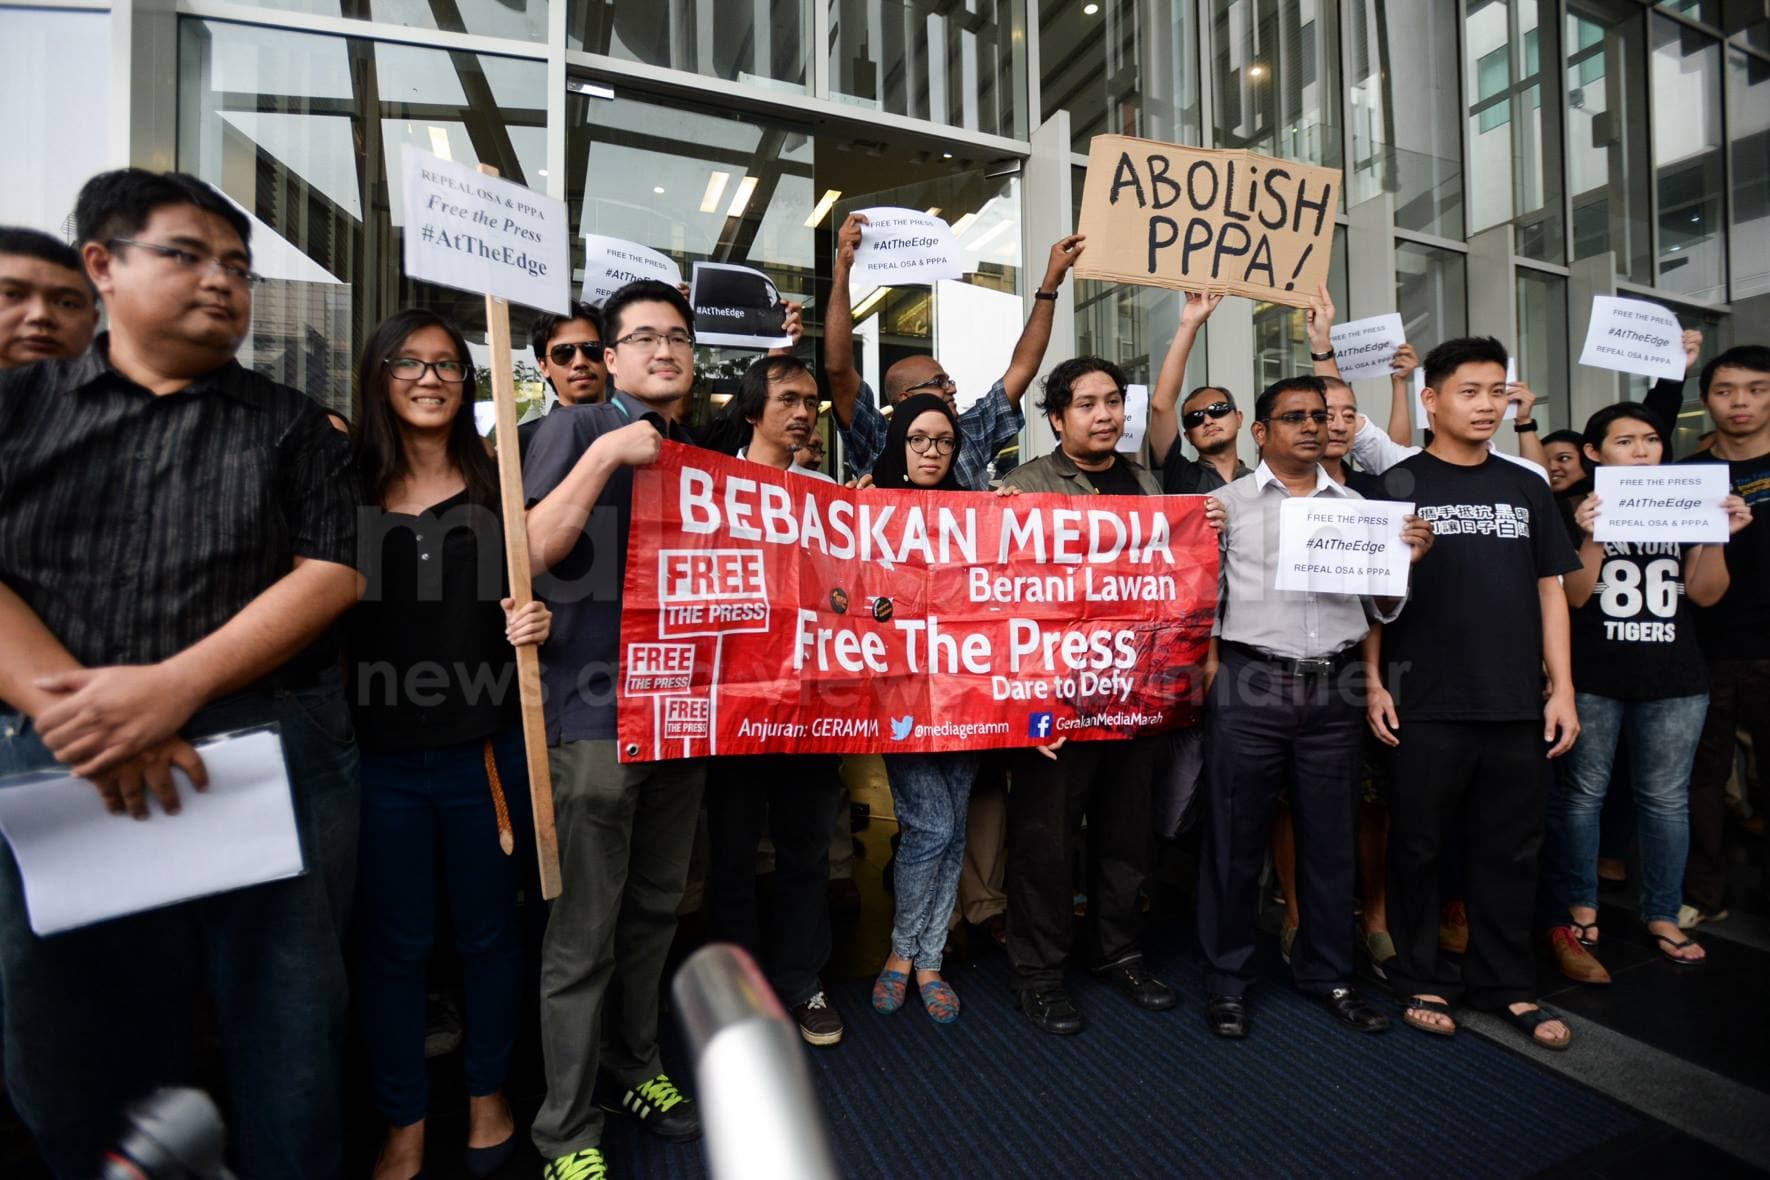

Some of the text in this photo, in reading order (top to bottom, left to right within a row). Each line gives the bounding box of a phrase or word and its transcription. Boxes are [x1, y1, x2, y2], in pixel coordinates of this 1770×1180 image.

[421, 168, 546, 221] REPEAL OSA & PPPA
[426, 193, 542, 244] Free the Press
[870, 218, 935, 228] FREE THE PRESS
[421, 223, 548, 278] #AtTheEdge
[872, 236, 940, 251] #AtTheEdge
[606, 248, 668, 271] FREE THE PRESS
[867, 261, 899, 271] REPEAL
[900, 259, 917, 269] OSA
[926, 256, 948, 266] PPPA
[594, 287, 617, 298] REP
[696, 305, 745, 319] #AtTheEdge
[1612, 308, 1674, 327] FREE THE PRESS
[1347, 330, 1361, 339] THE
[1362, 325, 1386, 335] PRESS
[1607, 327, 1671, 348] #AtTheEdge
[1336, 340, 1390, 359] AtTheEdge
[1595, 345, 1625, 357] REPEAL
[1626, 350, 1642, 361] OSA
[1650, 355, 1672, 366] PPPA
[1354, 361, 1370, 370] OSA
[1619, 478, 1703, 487] FREE THE PRESS
[1618, 497, 1703, 510] #AtTheEdge
[679, 466, 1175, 567] BEBASKAN MEDIA
[1306, 513, 1389, 526] FREE THE PRESS
[1608, 519, 1646, 527] REPEAL
[1647, 519, 1669, 527] OSA
[1681, 519, 1710, 527] PPPA
[1305, 537, 1386, 555] #AtTheEdge
[666, 554, 762, 596] FREE
[1293, 563, 1391, 577] REPEAL OSA & PPPA
[969, 566, 1176, 603] Berani Lawan
[1599, 557, 1680, 619] 86
[667, 602, 766, 626] THE PRESS
[794, 606, 889, 673] Free
[894, 615, 991, 675] The
[1009, 617, 1137, 672] Press
[1603, 621, 1677, 643] TIGERS
[630, 646, 692, 672] FREE
[629, 676, 689, 690] THE PRESS
[991, 674, 1049, 702] Dare
[1053, 676, 1076, 700] to
[1079, 669, 1135, 702] Defy
[667, 700, 708, 720] FREE
[667, 722, 706, 733] THE PRESS
[737, 717, 879, 744] Anjuran: GERAMM
[913, 718, 1010, 740] @mediageramm
[1055, 710, 1164, 733] GerakanMediaMarah
